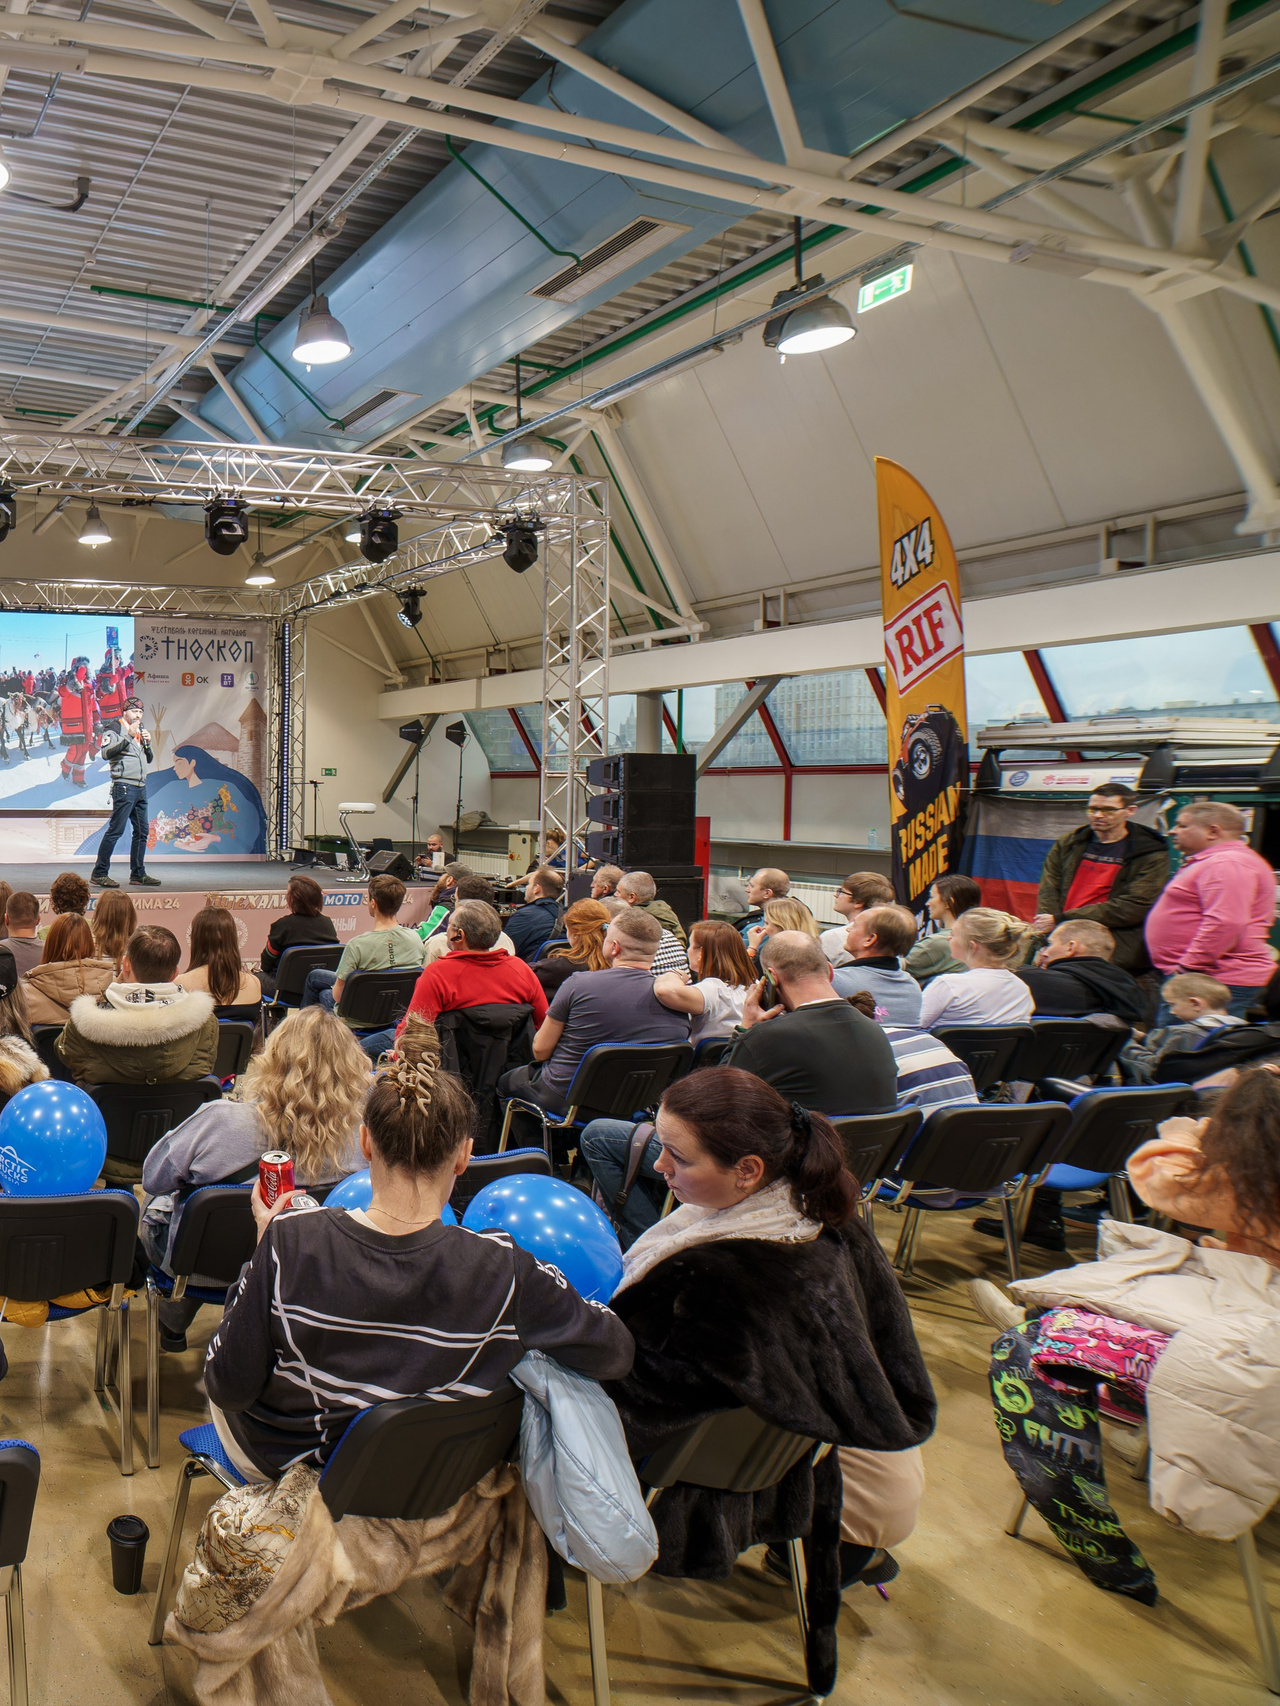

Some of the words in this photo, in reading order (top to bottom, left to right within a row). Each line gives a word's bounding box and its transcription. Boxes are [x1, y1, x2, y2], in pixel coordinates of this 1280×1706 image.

[890, 516, 935, 591] 4X4
[895, 601, 945, 677] RIF
[324, 894, 360, 905] МОТО
[909, 834, 949, 901] MADE
[164, 898, 181, 910] 24
